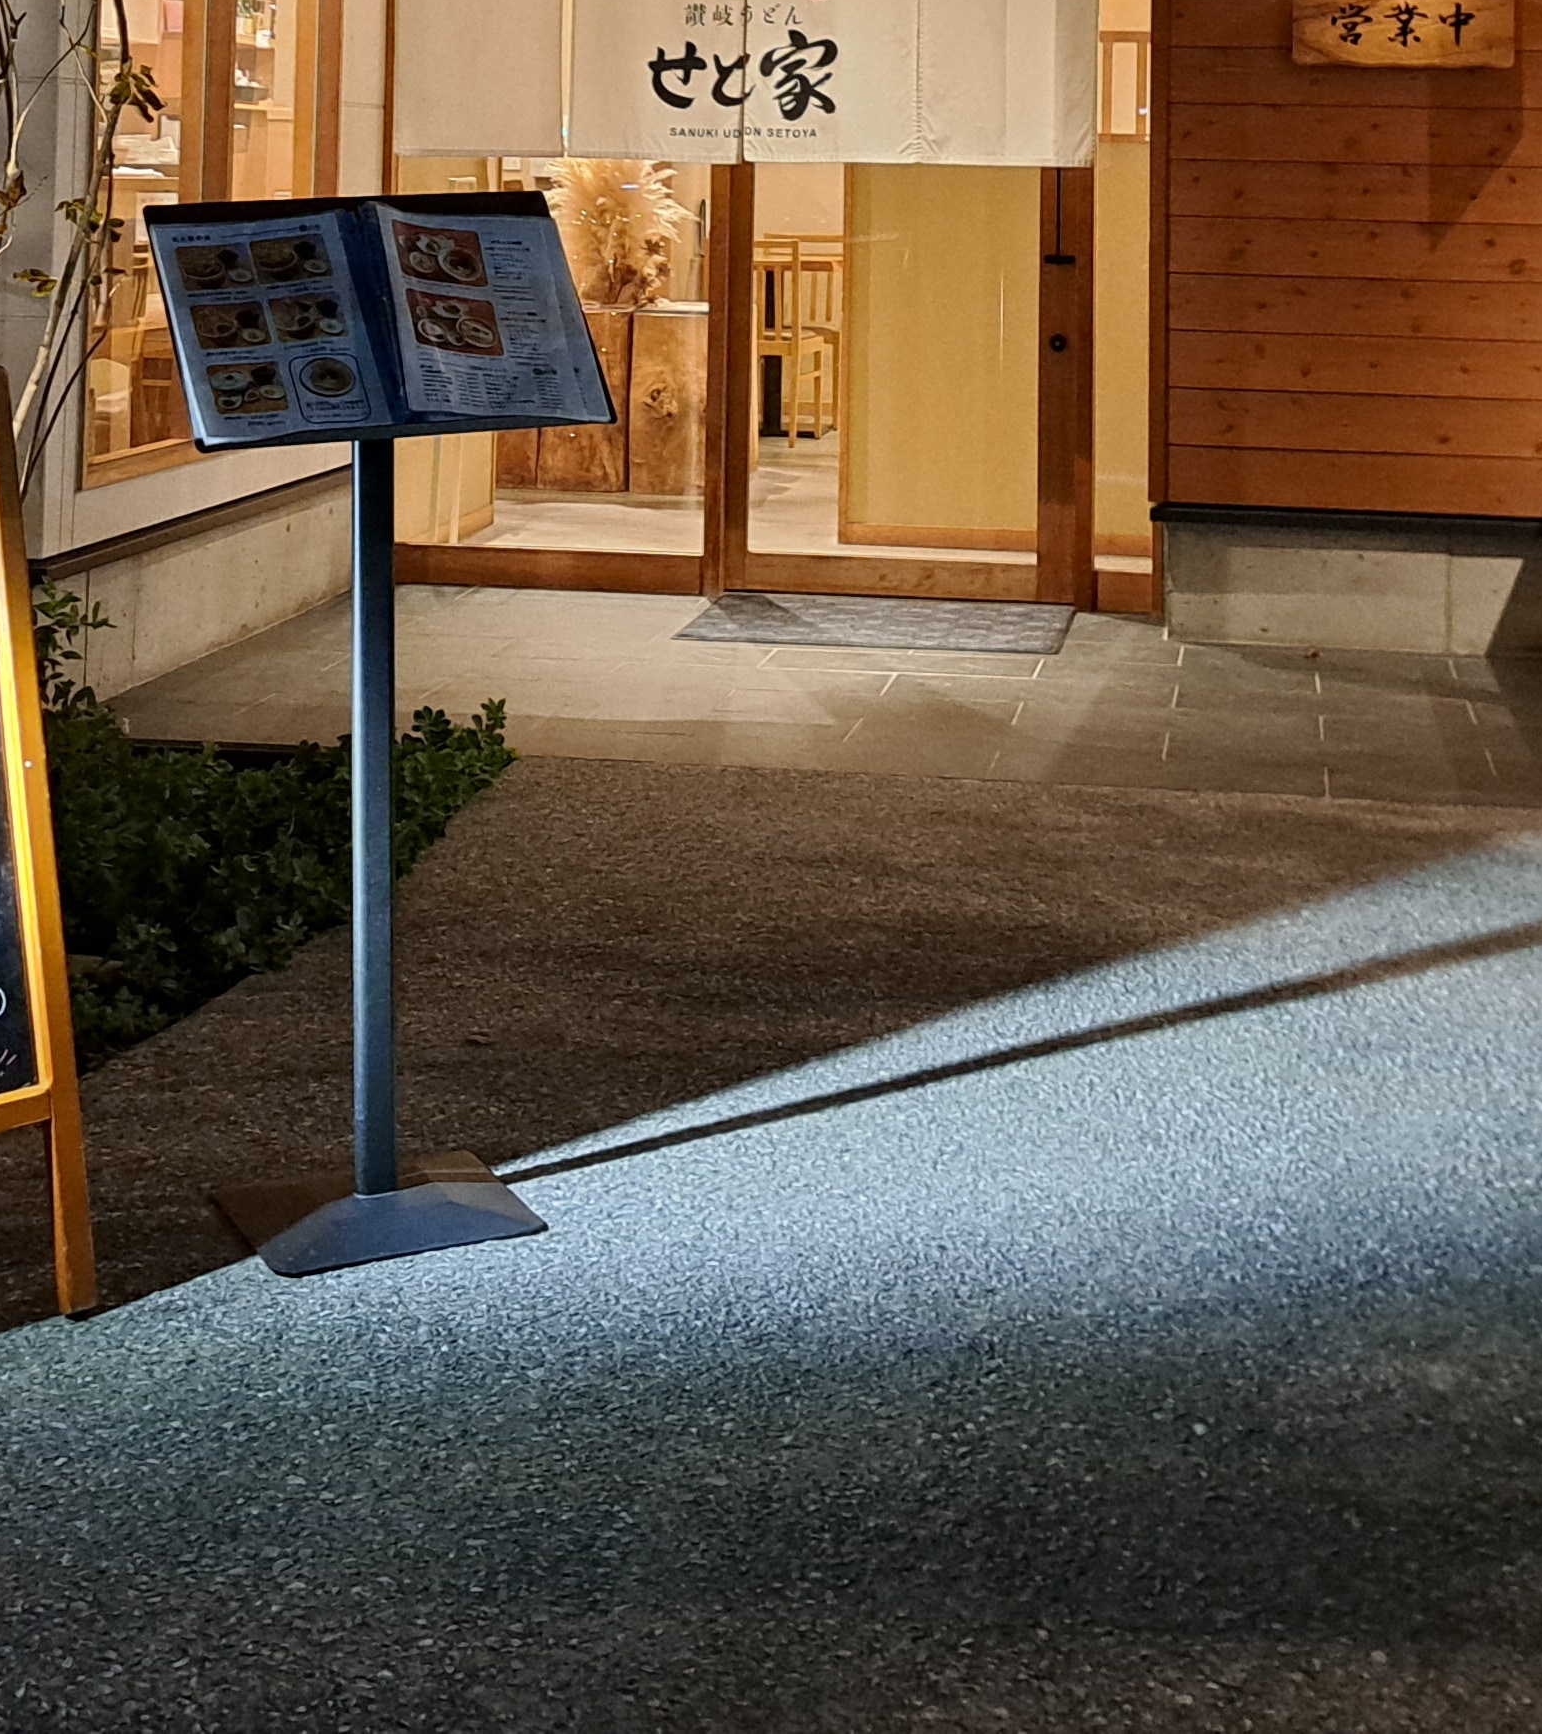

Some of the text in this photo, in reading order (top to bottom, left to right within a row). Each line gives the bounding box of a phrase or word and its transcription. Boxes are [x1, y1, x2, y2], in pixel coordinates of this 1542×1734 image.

[1330, 1, 1476, 48] 営業中
[647, 29, 839, 121] せと家
[668, 125, 818, 139] SANUKI UDON SETOYA
